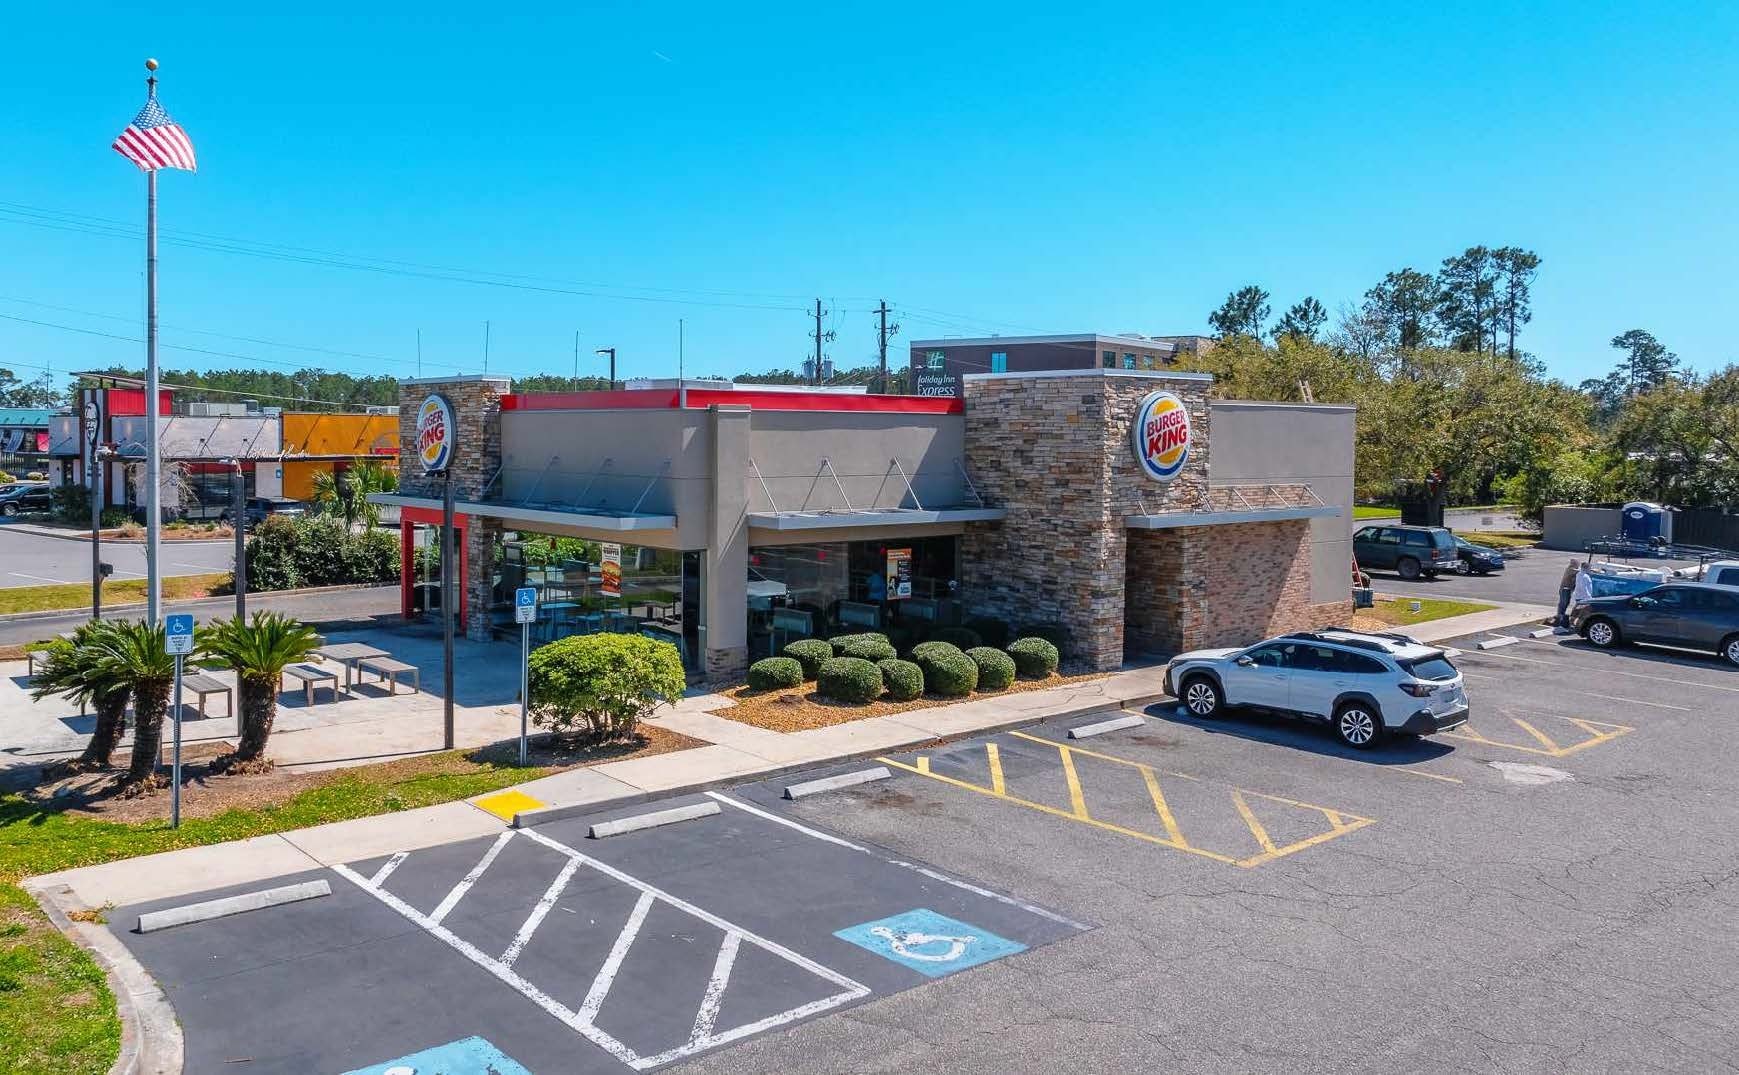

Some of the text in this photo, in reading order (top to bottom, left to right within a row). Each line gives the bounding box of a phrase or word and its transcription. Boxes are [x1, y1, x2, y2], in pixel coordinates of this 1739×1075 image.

[943, 374, 955, 383] Inn
[918, 385, 955, 396] Express
[1147, 410, 1185, 438] BURGER
[1148, 424, 1187, 459] KING
